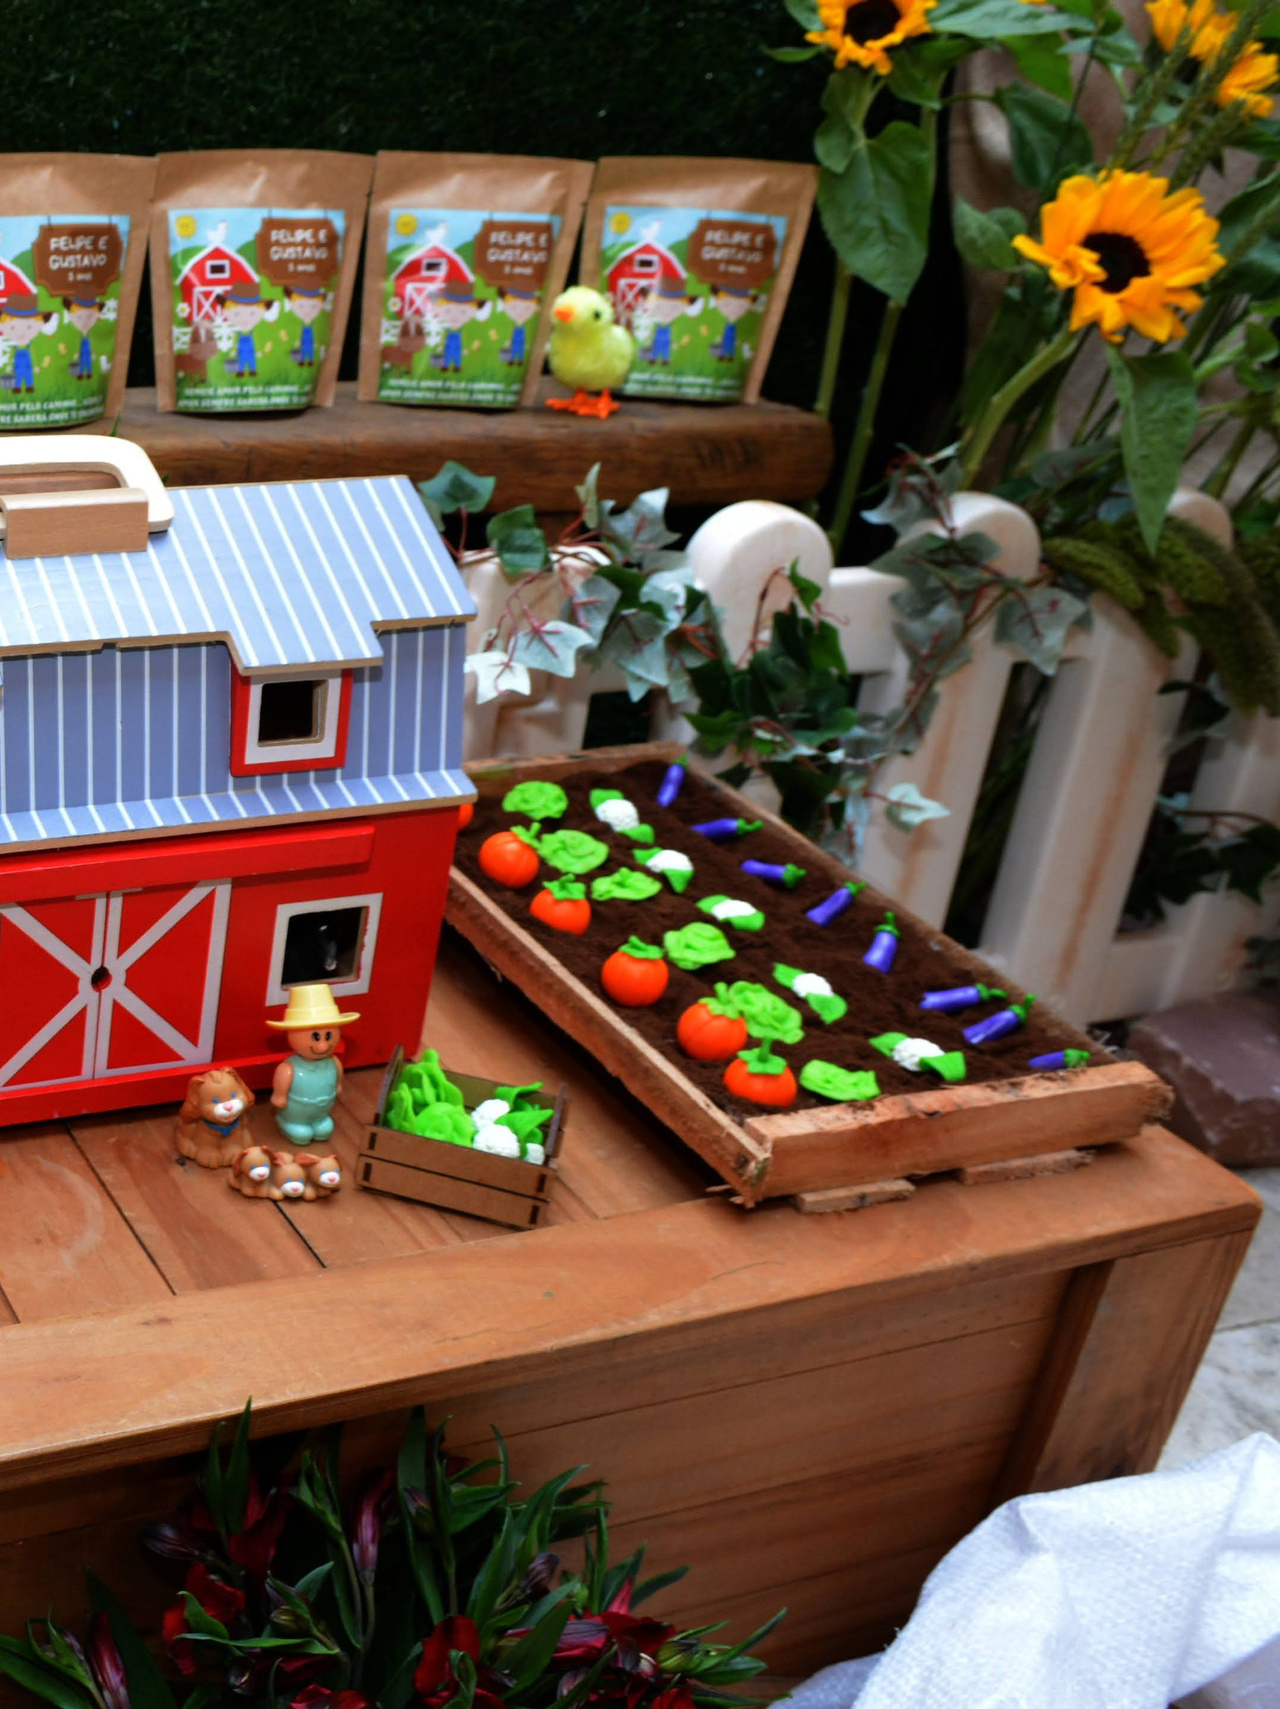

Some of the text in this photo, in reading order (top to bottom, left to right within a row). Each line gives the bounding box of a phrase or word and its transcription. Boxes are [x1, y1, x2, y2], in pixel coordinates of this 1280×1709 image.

[50, 234, 109, 251] FELIPE E
[49, 253, 107, 270] GUSTAVO
